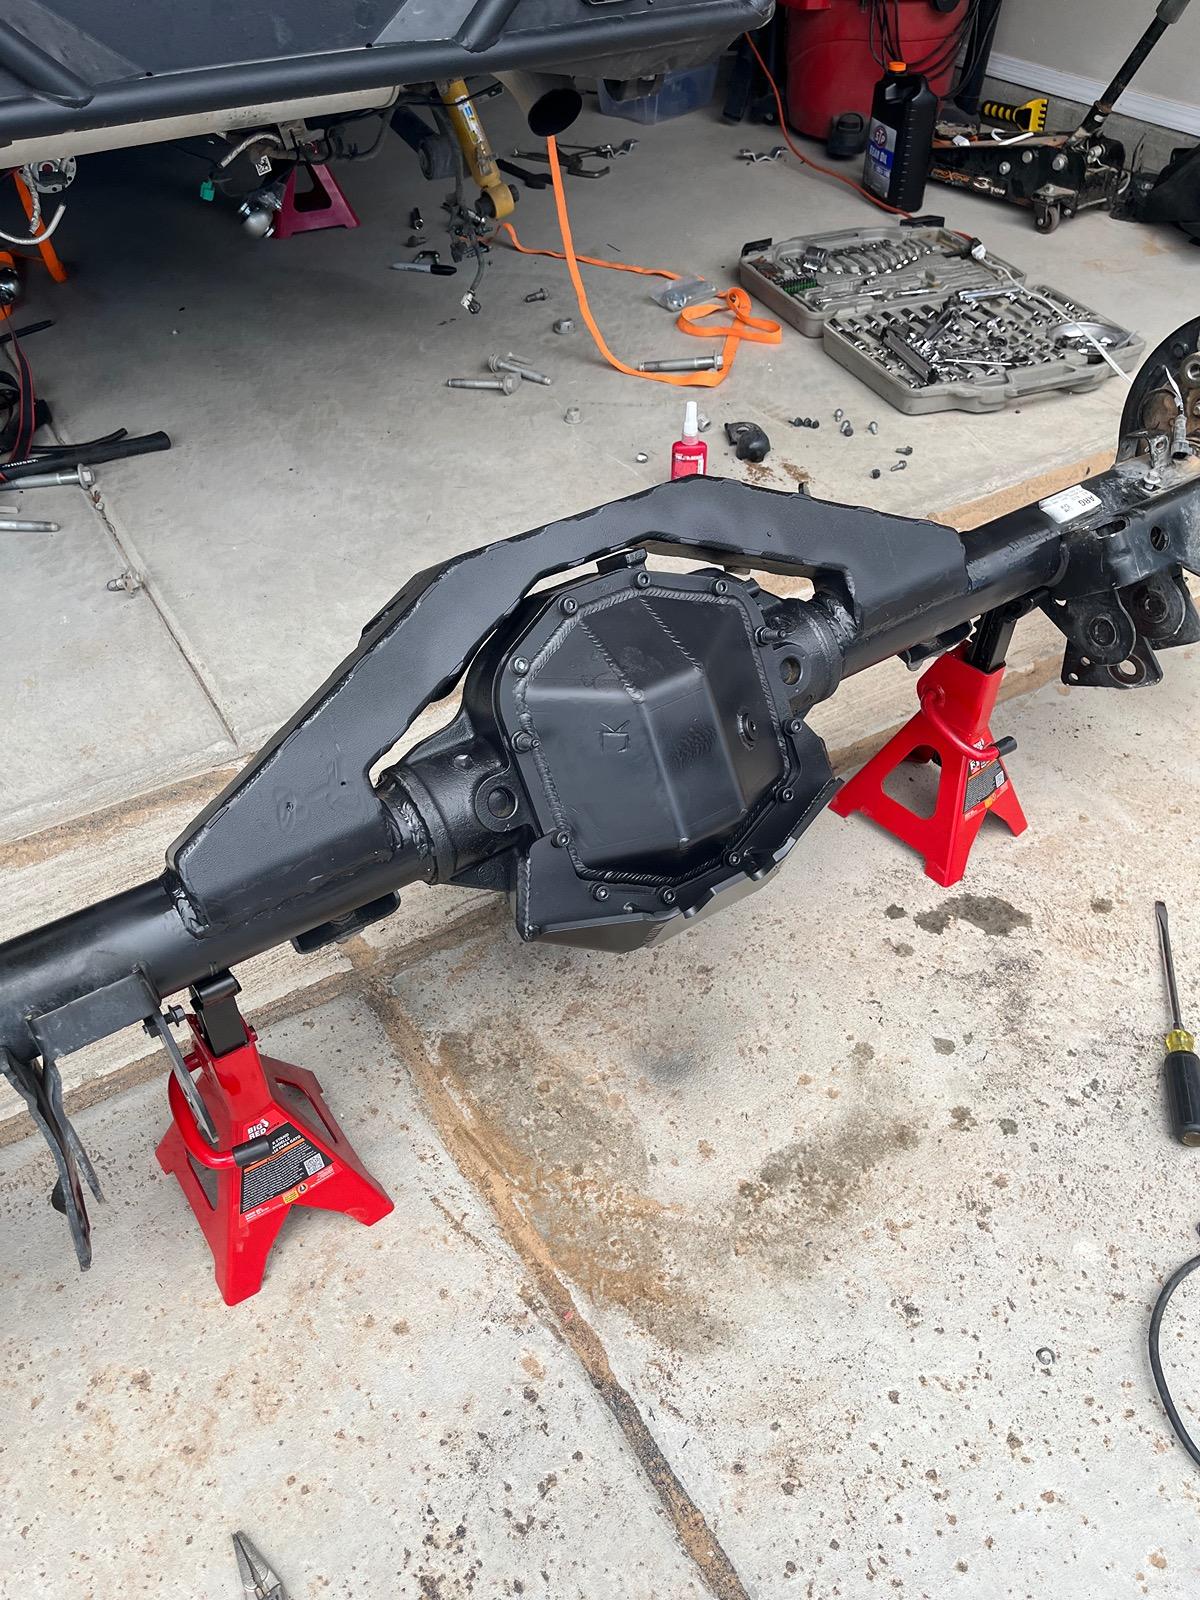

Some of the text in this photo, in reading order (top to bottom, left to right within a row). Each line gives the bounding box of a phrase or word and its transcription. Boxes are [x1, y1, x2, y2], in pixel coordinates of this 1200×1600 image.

[875, 127, 886, 145] STP
[973, 177, 992, 189] 3
[990, 187, 1006, 195] TON
[247, 1122, 264, 1135] BIG
[248, 1127, 267, 1140] RED
